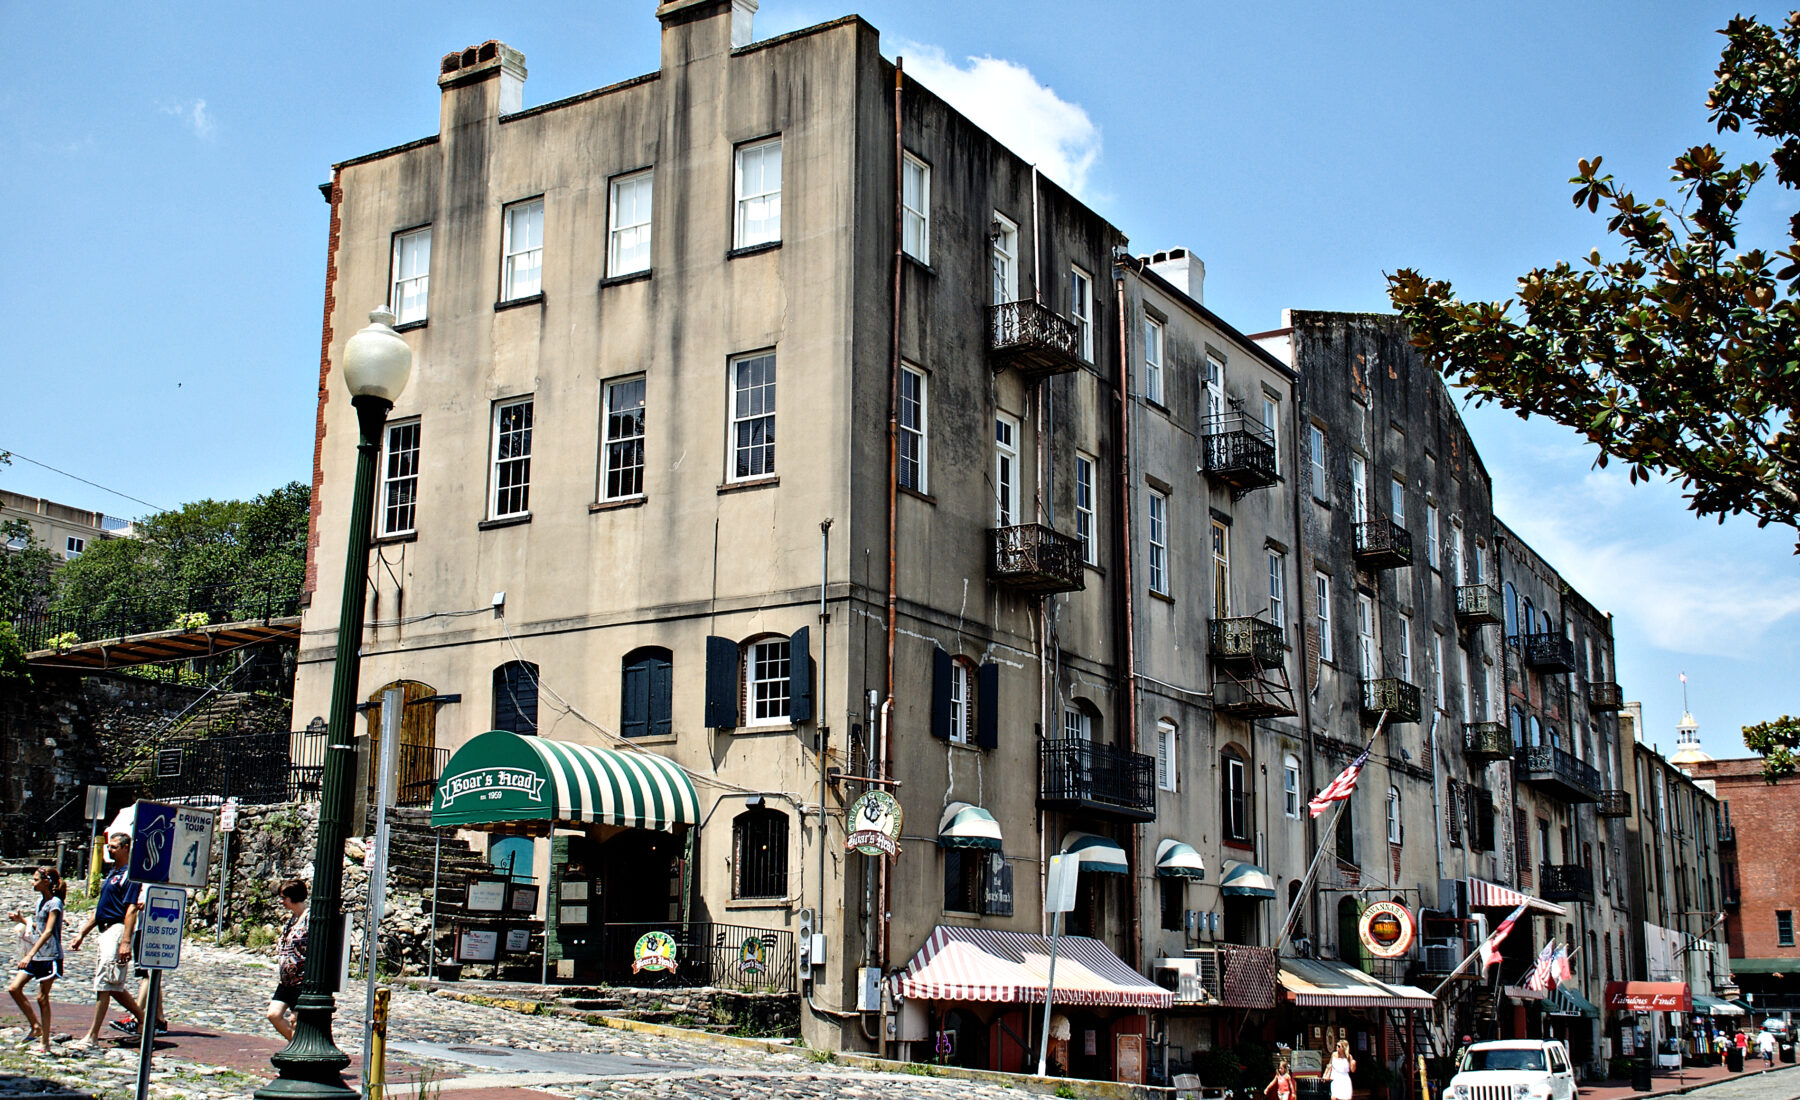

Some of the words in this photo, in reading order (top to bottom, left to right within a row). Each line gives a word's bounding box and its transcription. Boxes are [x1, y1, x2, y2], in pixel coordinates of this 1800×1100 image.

[451, 772, 493, 794] Boar's
[497, 771, 533, 789] Head
[179, 813, 212, 825] DRIVING
[185, 822, 205, 833] TOUR
[847, 831, 875, 848] Boar's
[875, 832, 897, 857] Head
[182, 840, 199, 878] 4
[147, 925, 160, 935] BUS
[161, 926, 178, 936] STOP
[145, 942, 161, 950] LOCAL
[144, 950, 160, 958] BUSES
[161, 951, 175, 959] ONLY
[1038, 988, 1092, 1002] SAANNAH'S
[1093, 991, 1120, 1003] CANDY
[1122, 992, 1158, 1005] KITCHEN
[1612, 993, 1648, 1005] Fabulous
[1652, 993, 1677, 1005] Finds
